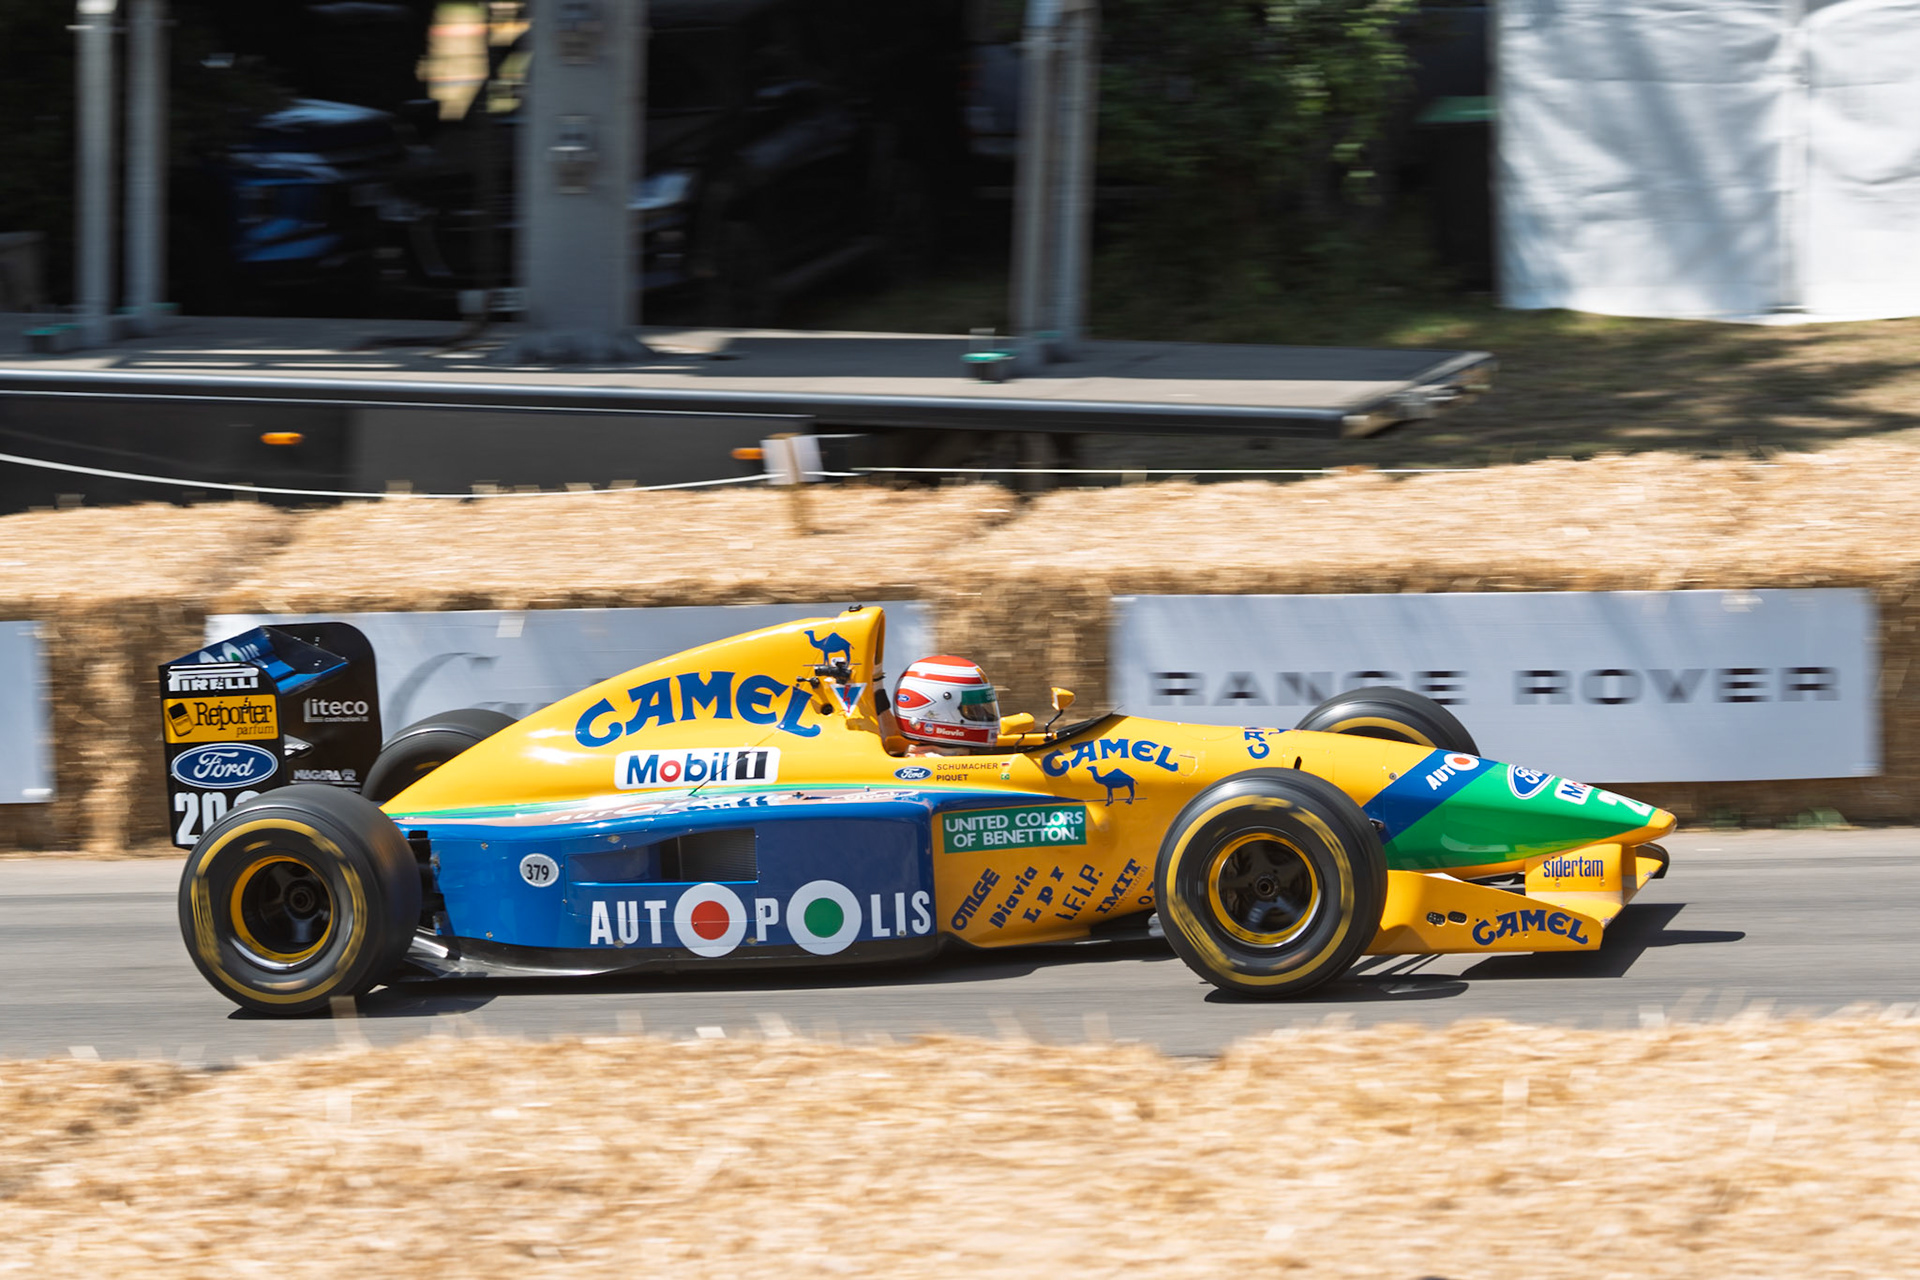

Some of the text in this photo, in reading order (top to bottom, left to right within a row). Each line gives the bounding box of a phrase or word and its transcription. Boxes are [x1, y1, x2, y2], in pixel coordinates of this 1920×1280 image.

[168, 663, 259, 692] PIRELLI
[1513, 667, 1840, 705] ROVER
[575, 671, 821, 748] CAMEL
[236, 724, 274, 738] parfum
[626, 752, 730, 785] Mobil
[936, 763, 998, 771] SCHUMACHER
[1042, 738, 1179, 777] CAMEL
[936, 773, 969, 781] PIQUET
[945, 810, 1084, 833] UNITED COLORS
[953, 832, 977, 849] OF
[526, 864, 550, 881] 379
[1543, 856, 1604, 878] sidertam
[989, 866, 1038, 929] Diavia
[1095, 858, 1141, 914] IMIT
[590, 880, 931, 957] AUTOPOLIS
[1471, 909, 1589, 947] CAMEL
